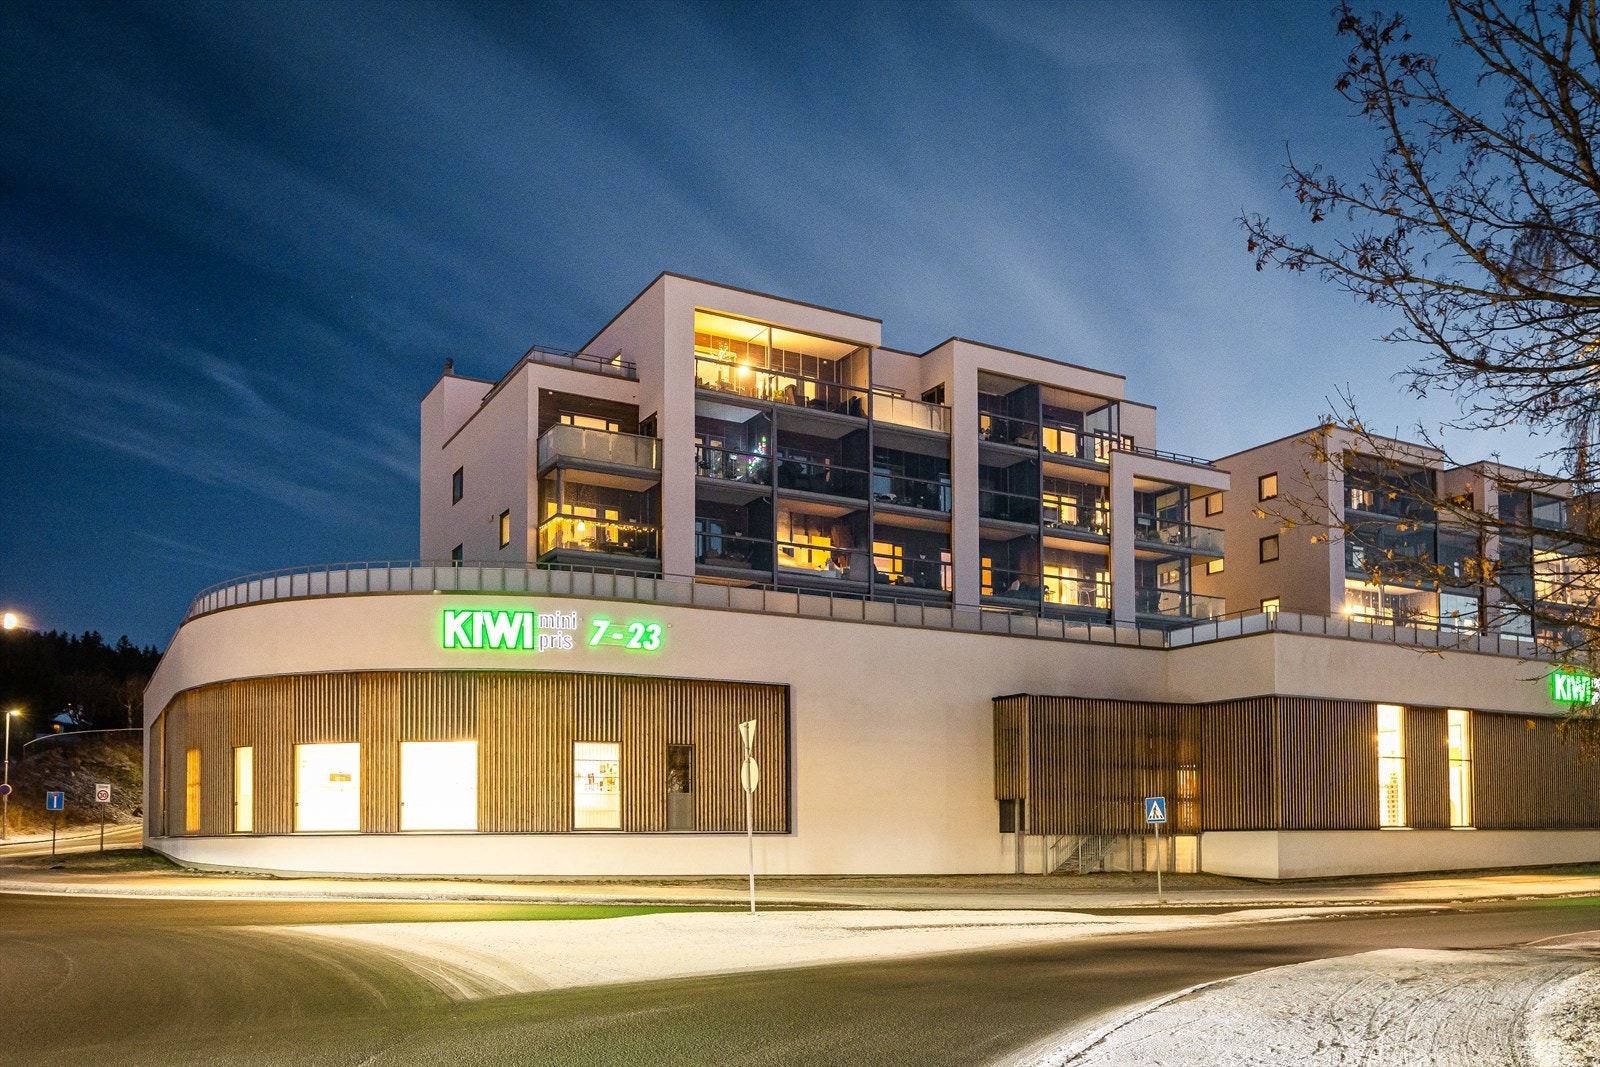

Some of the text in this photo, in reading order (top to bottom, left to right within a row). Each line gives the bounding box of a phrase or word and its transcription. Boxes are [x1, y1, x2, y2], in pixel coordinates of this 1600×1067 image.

[444, 610, 534, 649] KIWI
[539, 611, 577, 629] mini
[538, 630, 574, 652] pris
